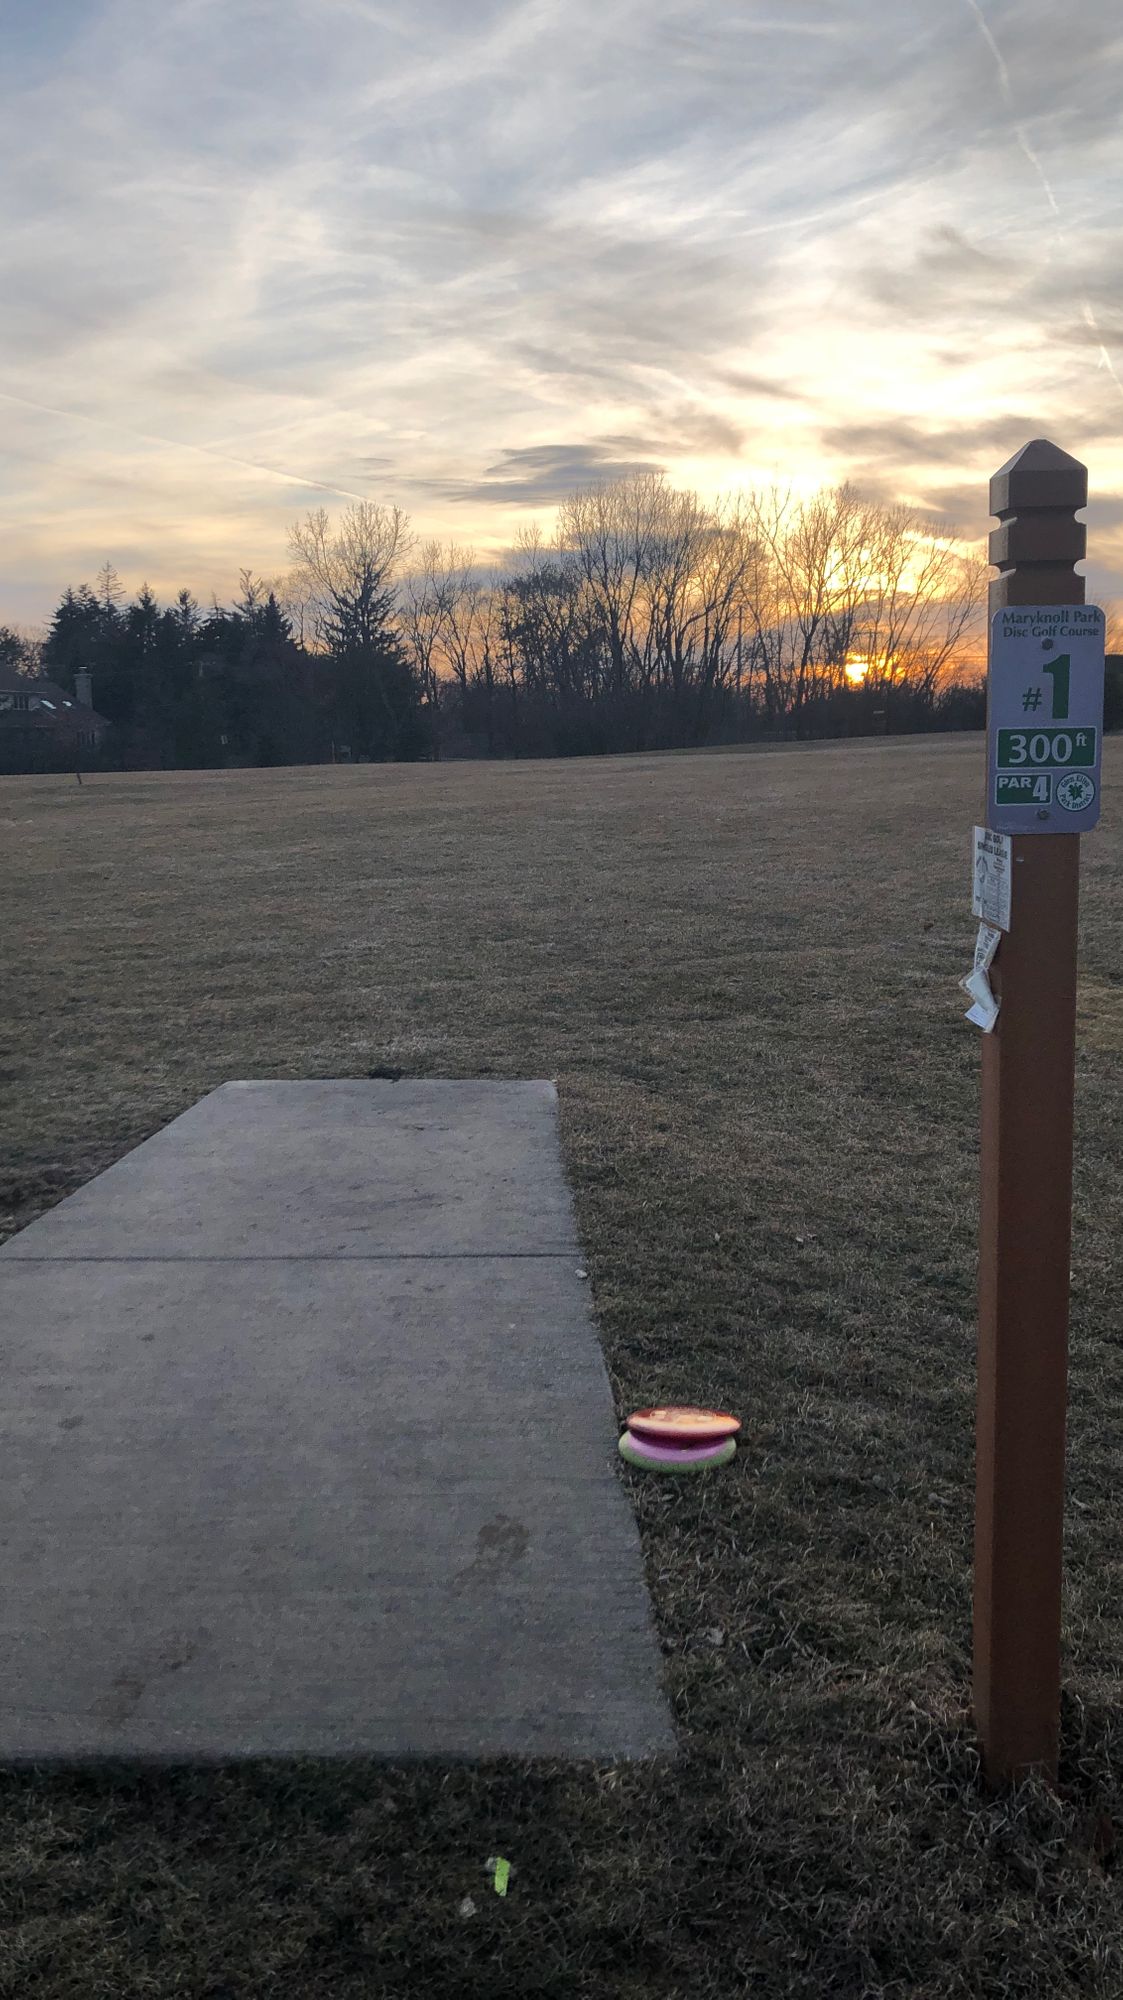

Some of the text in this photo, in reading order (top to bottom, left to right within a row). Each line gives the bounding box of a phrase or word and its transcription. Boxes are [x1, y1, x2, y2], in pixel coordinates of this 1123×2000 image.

[1002, 609, 1101, 626] Maryknoll Park
[1003, 625, 1099, 637] Disc Golf Course
[998, 776, 1048, 802] PAR 4
